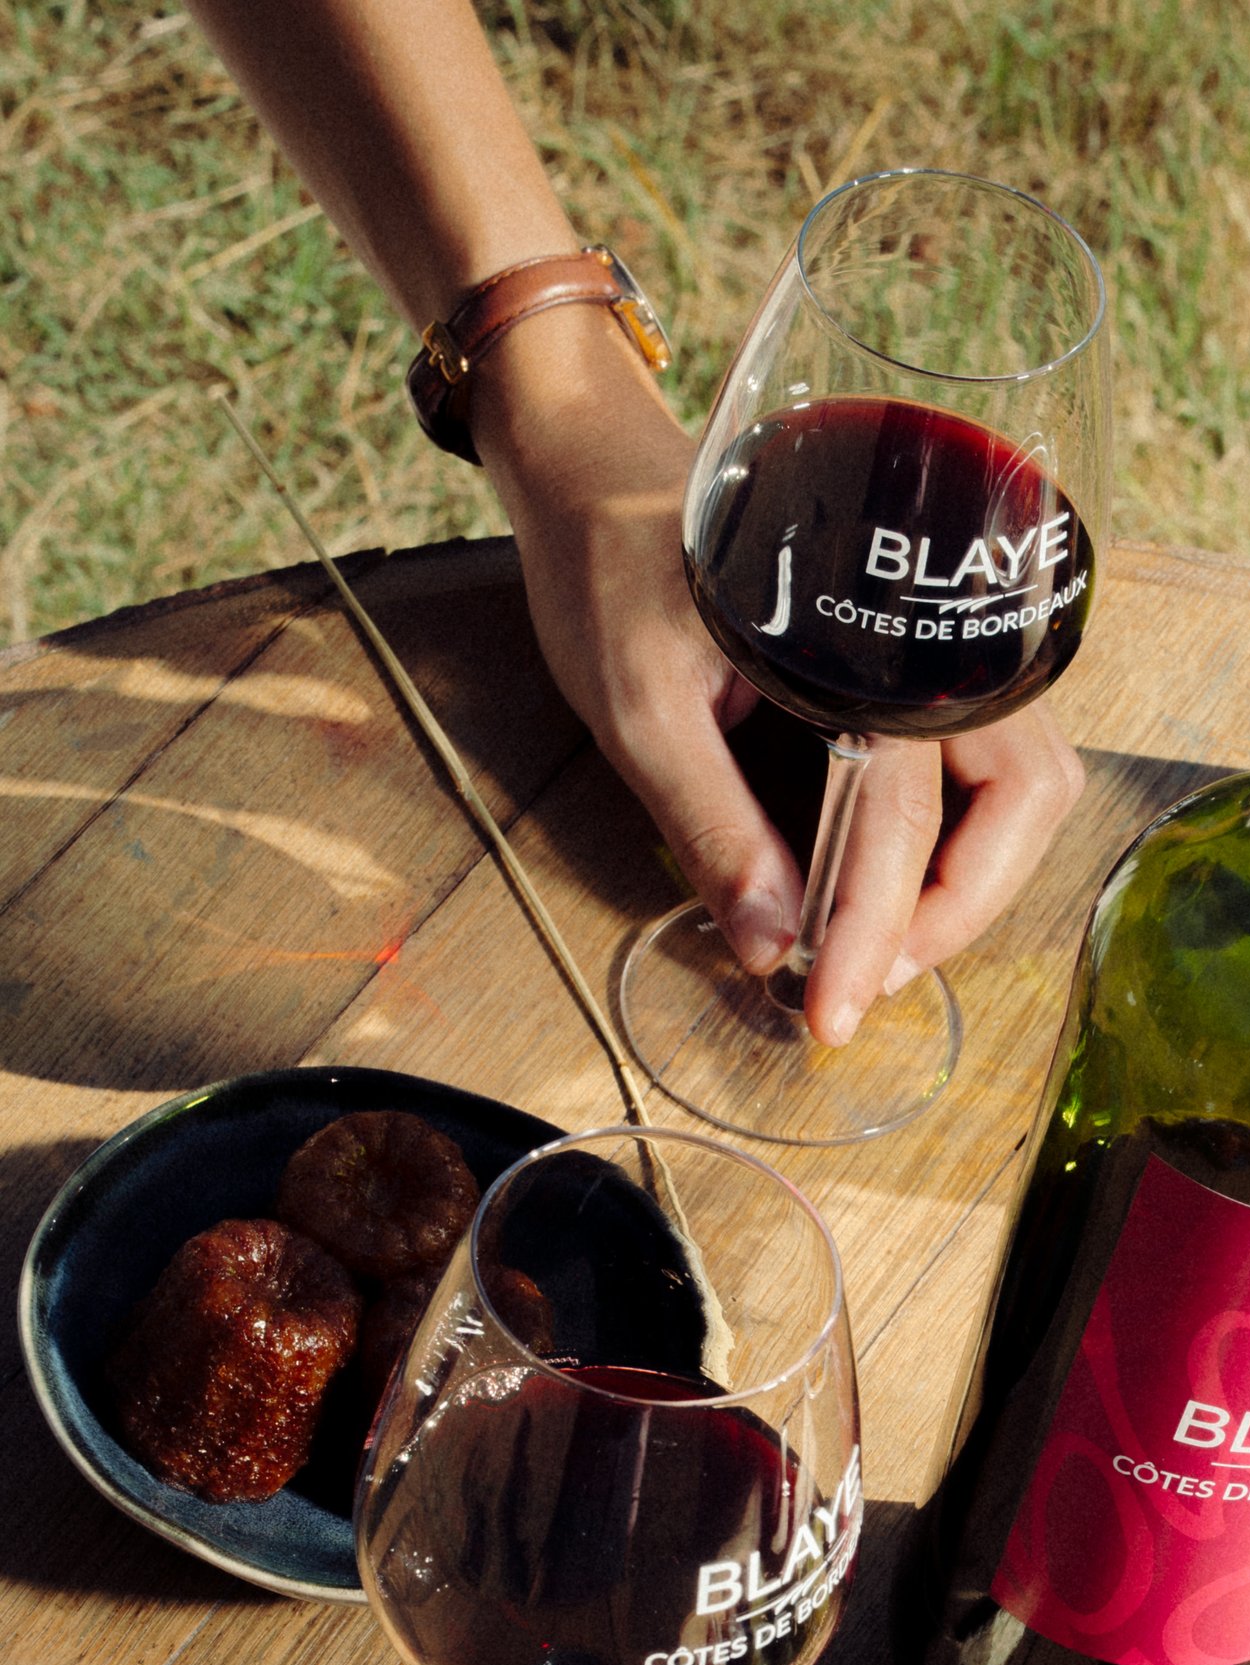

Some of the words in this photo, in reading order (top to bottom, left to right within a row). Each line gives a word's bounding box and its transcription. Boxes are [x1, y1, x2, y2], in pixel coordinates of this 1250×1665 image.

[865, 511, 1070, 587] BLAYE
[815, 594, 907, 637] CÔTES
[914, 618, 955, 641] DE
[961, 569, 1088, 640] BORDEAUX
[1112, 1454, 1216, 1499] CÔTES
[695, 1443, 862, 1616] BLAYE
[754, 1612, 793, 1651] DE
[796, 1512, 863, 1625] BORDE
